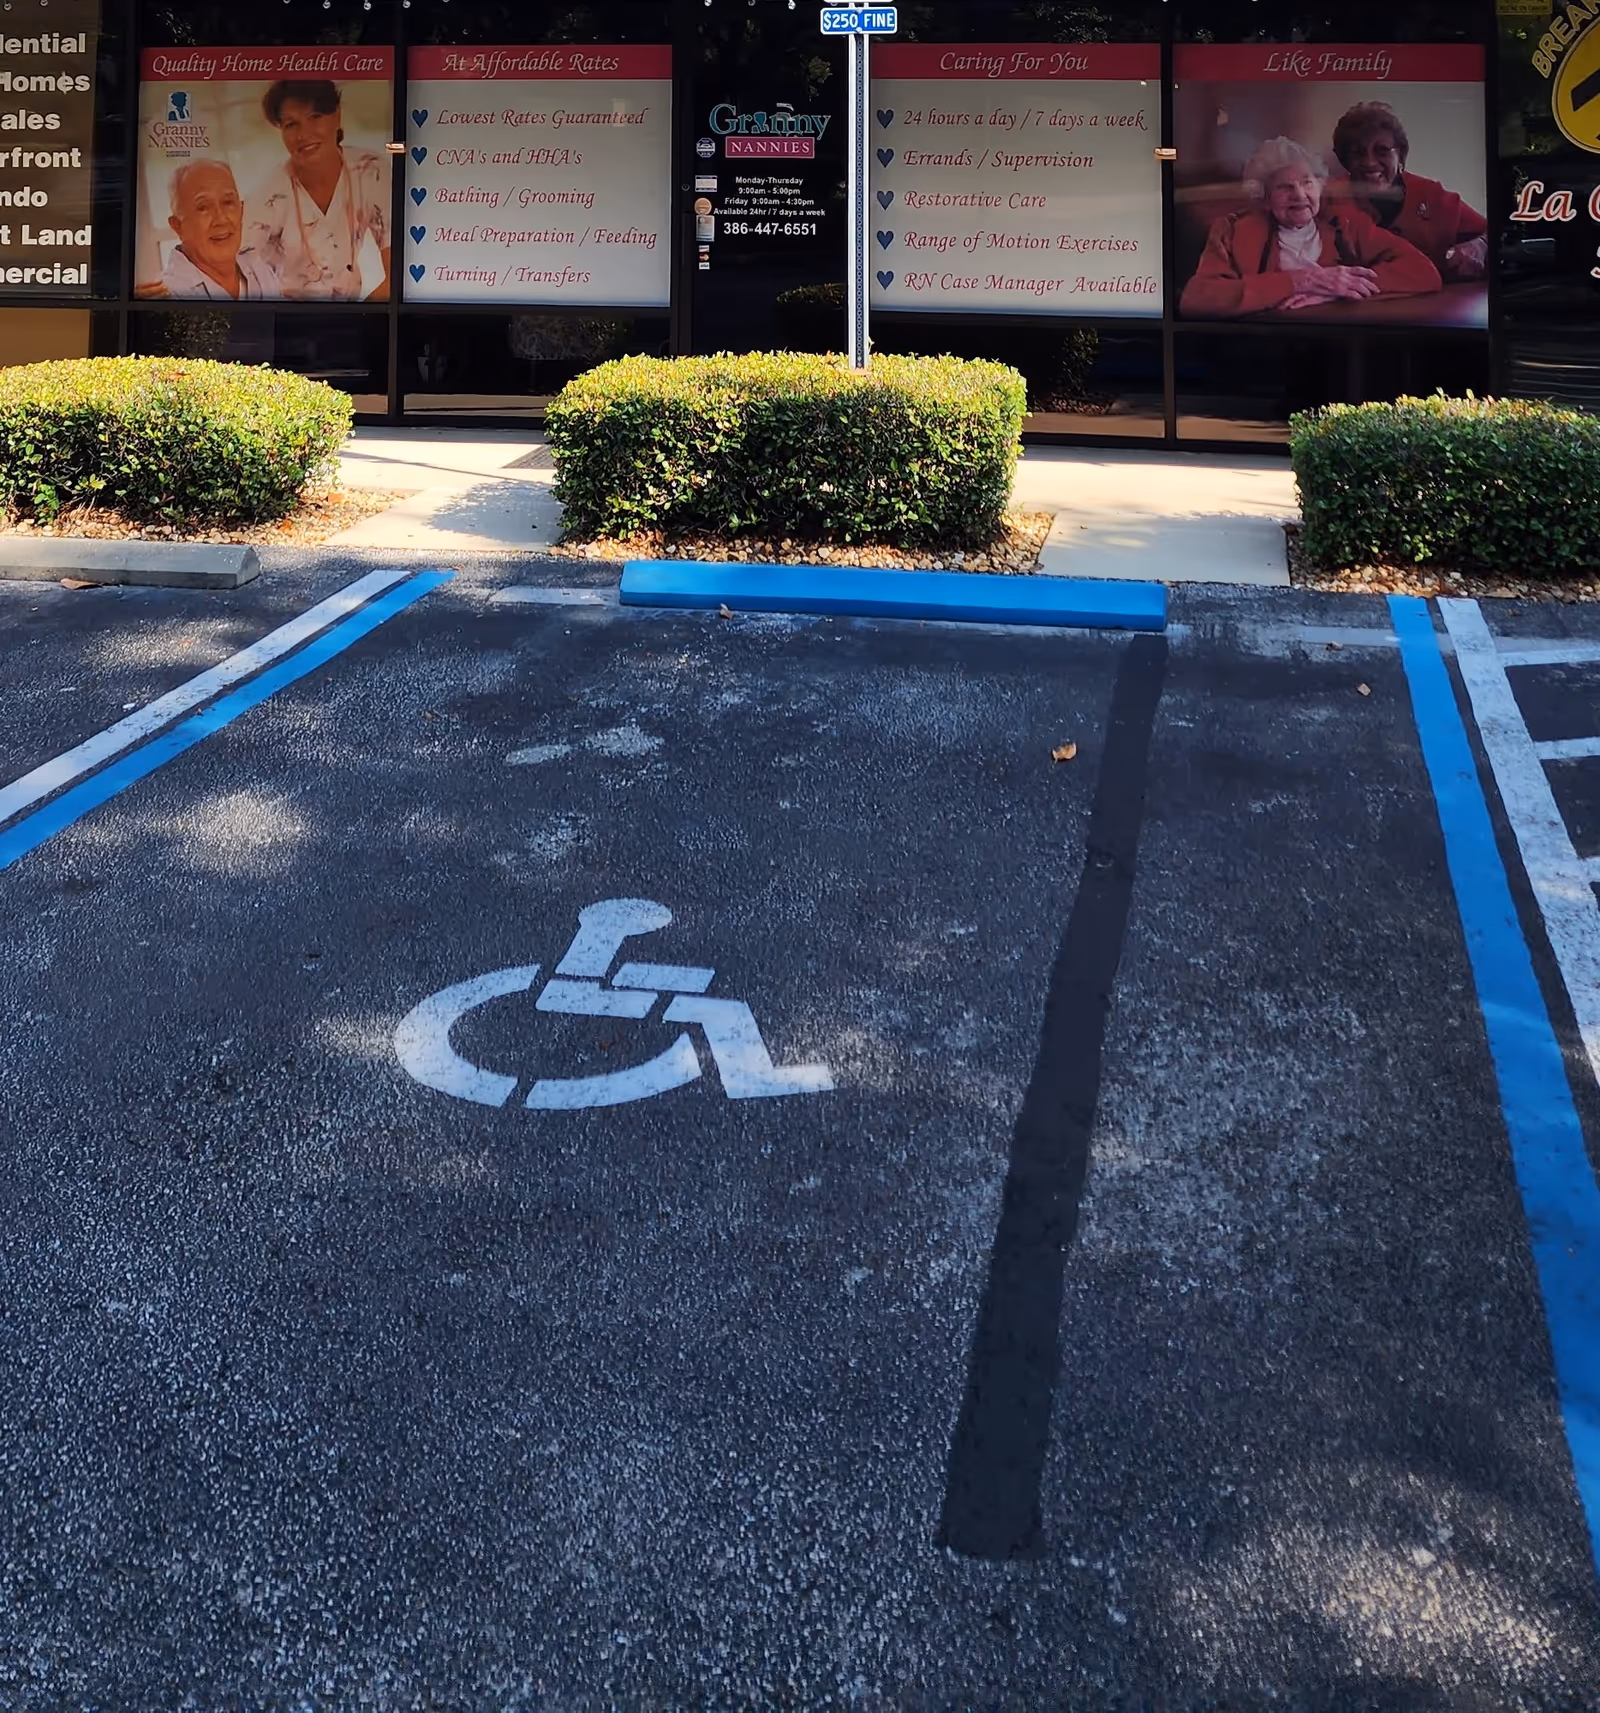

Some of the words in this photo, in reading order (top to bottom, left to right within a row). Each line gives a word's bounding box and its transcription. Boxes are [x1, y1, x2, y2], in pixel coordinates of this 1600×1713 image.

[823, 12, 858, 30] $250
[864, 13, 895, 28] FINE
[0, 32, 86, 54] ential
[152, 52, 218, 79] Quality
[221, 53, 273, 72] Home
[277, 51, 339, 72] Health
[343, 53, 384, 72] Care
[442, 53, 467, 71] At
[470, 50, 564, 78] Affordable
[568, 53, 620, 74] Rates
[940, 51, 1006, 78] Caring
[1009, 52, 1045, 74] For
[1049, 52, 1089, 75] You
[1263, 51, 1311, 78] Like
[1318, 50, 1394, 79] Family
[1, 110, 61, 130] ales
[435, 109, 496, 125] Lowest
[501, 109, 546, 127] Rates
[551, 107, 650, 129] Guaranteed
[903, 110, 922, 125] 24
[928, 108, 970, 125] hours
[974, 113, 984, 125] a
[988, 108, 1018, 131] day
[1020, 109, 1032, 130] /
[1035, 110, 1045, 126] 7
[1049, 109, 1084, 131] days
[1089, 114, 1099, 126] a
[1104, 109, 1148, 131] week
[153, 122, 208, 137] Granny
[148, 134, 210, 148] NANNIES
[730, 141, 811, 154] NANNIES
[436, 149, 487, 166] CNA's
[492, 147, 526, 164] and
[525, 149, 582, 166] HHA's
[903, 148, 973, 166] Errands
[977, 149, 989, 170] /
[991, 151, 1094, 171] Supervision
[735, 176, 804, 186] Monday-Thursday
[738, 187, 766, 195] 9:00am
[772, 187, 801, 196] 5:00pm
[434, 186, 499, 208] Bathing
[503, 186, 516, 207] /
[518, 187, 595, 209] Grooming
[724, 197, 749, 206] Friday
[752, 197, 780, 205] 9:00am
[786, 197, 815, 206] 4:30pm
[903, 190, 1002, 208] Restorative
[1008, 192, 1047, 208] Care
[1509, 180, 1577, 222] La
[713, 207, 748, 215] Available
[779, 208, 797, 217] days
[806, 208, 826, 216] week
[21, 224, 92, 246] Land
[434, 226, 479, 243] Meal
[480, 227, 575, 247] Preparation
[578, 226, 591, 247] /
[593, 226, 657, 249] Feeding
[723, 222, 817, 235] 386-447-6551
[903, 231, 957, 253] Range
[963, 230, 984, 253] of
[985, 232, 1051, 250] Motion
[1056, 235, 1139, 253] Exercises
[0, 262, 88, 284] ercial
[433, 265, 497, 286] Turning
[501, 266, 513, 285] /
[515, 266, 591, 288] Transfers
[903, 272, 937, 291] RN
[940, 272, 978, 290] Case
[985, 274, 1064, 296] Manager
[1069, 275, 1157, 294] Available
